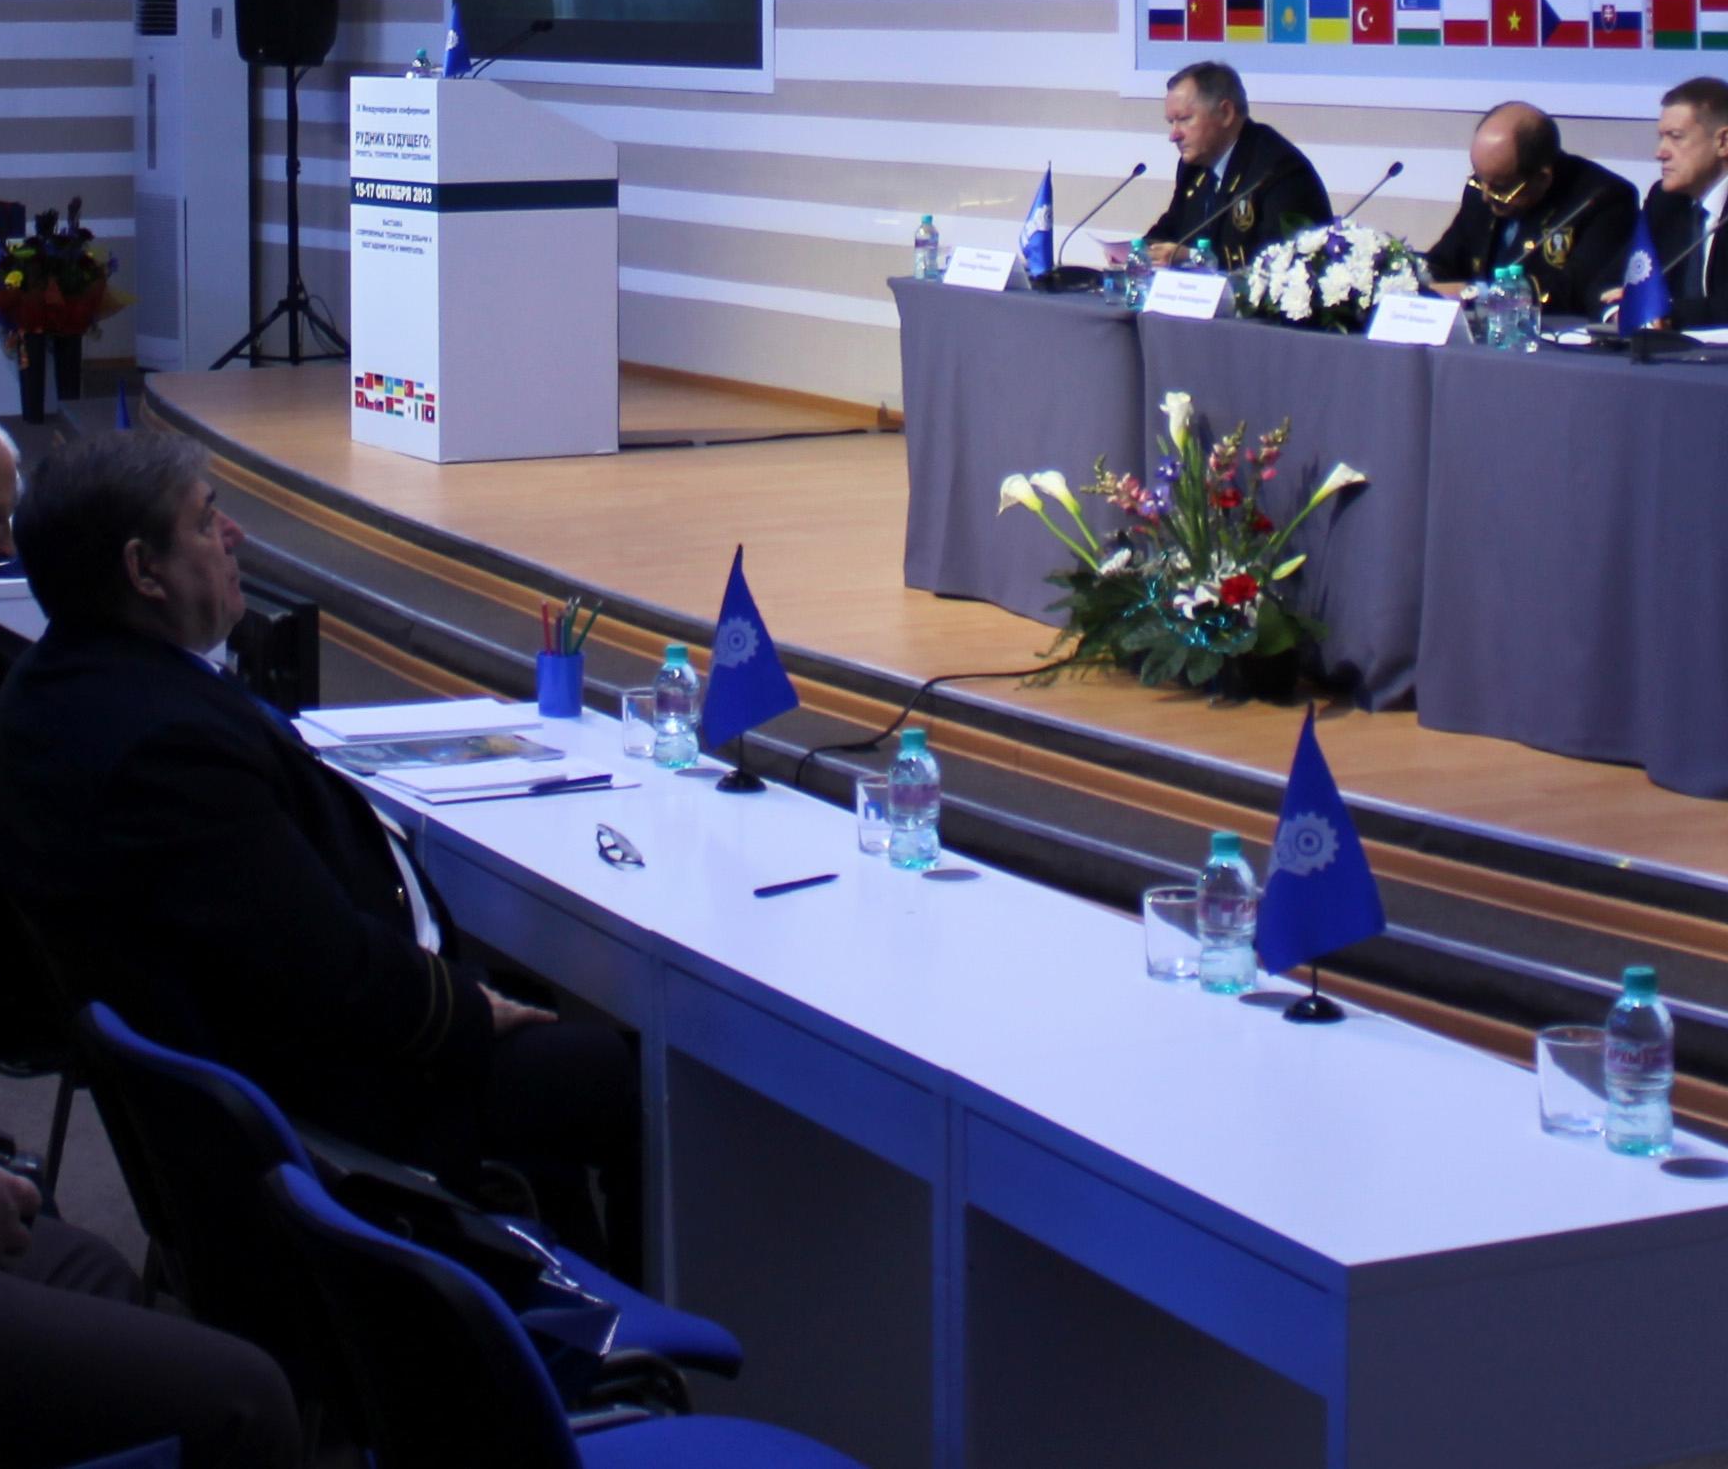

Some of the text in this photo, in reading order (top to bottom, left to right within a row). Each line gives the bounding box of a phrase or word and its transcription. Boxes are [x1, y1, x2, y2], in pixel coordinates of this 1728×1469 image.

[355, 131, 432, 150] РУДНИК БУДУЩЕГО:
[355, 182, 432, 204] 15-17 ОКТЯБРЯ 2013
